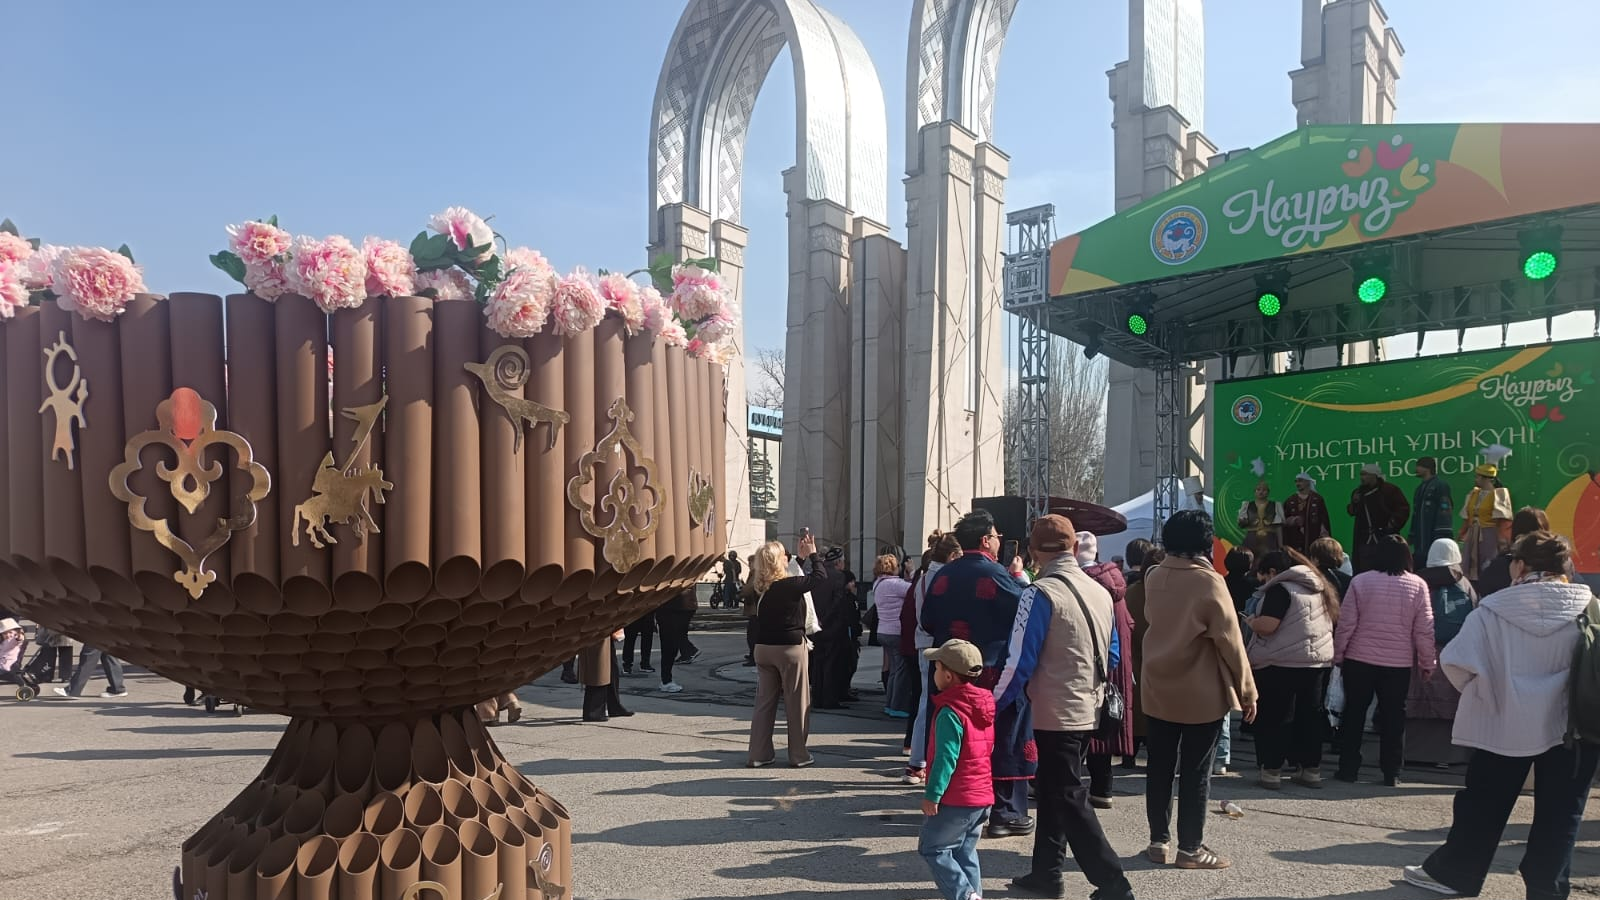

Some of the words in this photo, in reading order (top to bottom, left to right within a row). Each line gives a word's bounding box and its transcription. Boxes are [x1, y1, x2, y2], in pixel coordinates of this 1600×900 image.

[1222, 177, 1408, 248] Наурыз
[1480, 374, 1583, 407] Наурыз
[1275, 436, 1397, 461] ҰЛЫСТЫҢ
[1405, 431, 1462, 451] ҰЛЫ
[1300, 461, 1379, 481] ҰТТ
